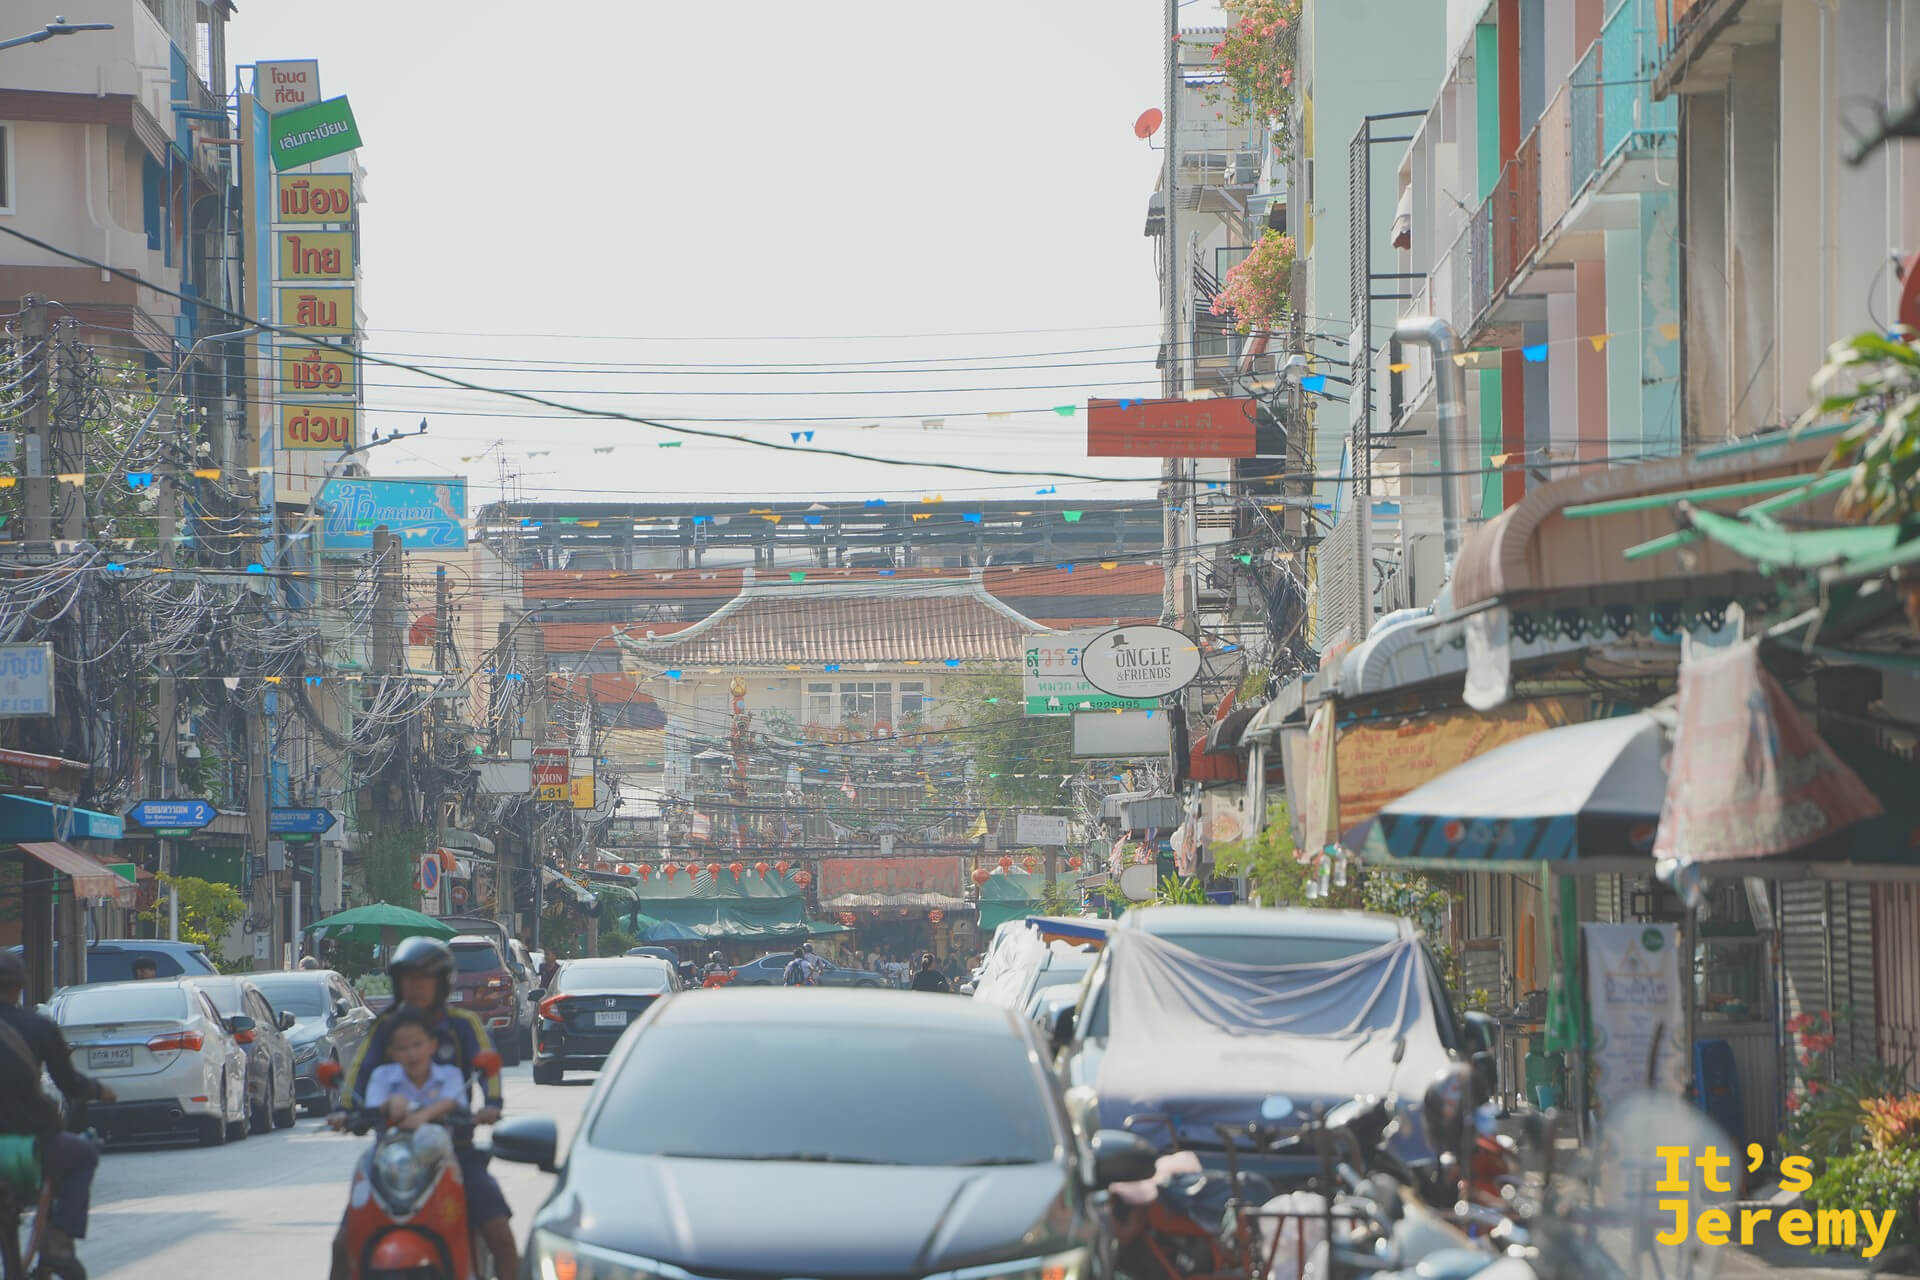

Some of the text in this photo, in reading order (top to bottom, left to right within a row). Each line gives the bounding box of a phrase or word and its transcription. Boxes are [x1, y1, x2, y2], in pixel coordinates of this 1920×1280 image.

[274, 85, 305, 103] ที่ดิน
[279, 120, 349, 150] เล่มทะเบียน
[280, 179, 349, 214] เมือง
[286, 236, 341, 274] ไทย
[296, 294, 337, 326] สิน
[292, 350, 342, 389] เชื่อ
[288, 408, 349, 442] ด่วน
[1026, 647, 1085, 678] สุวรร
[1115, 646, 1171, 668] UNCLE
[1116, 667, 1171, 681] &FRIENDS
[195, 806, 204, 819] 2
[316, 813, 324, 825] 3
